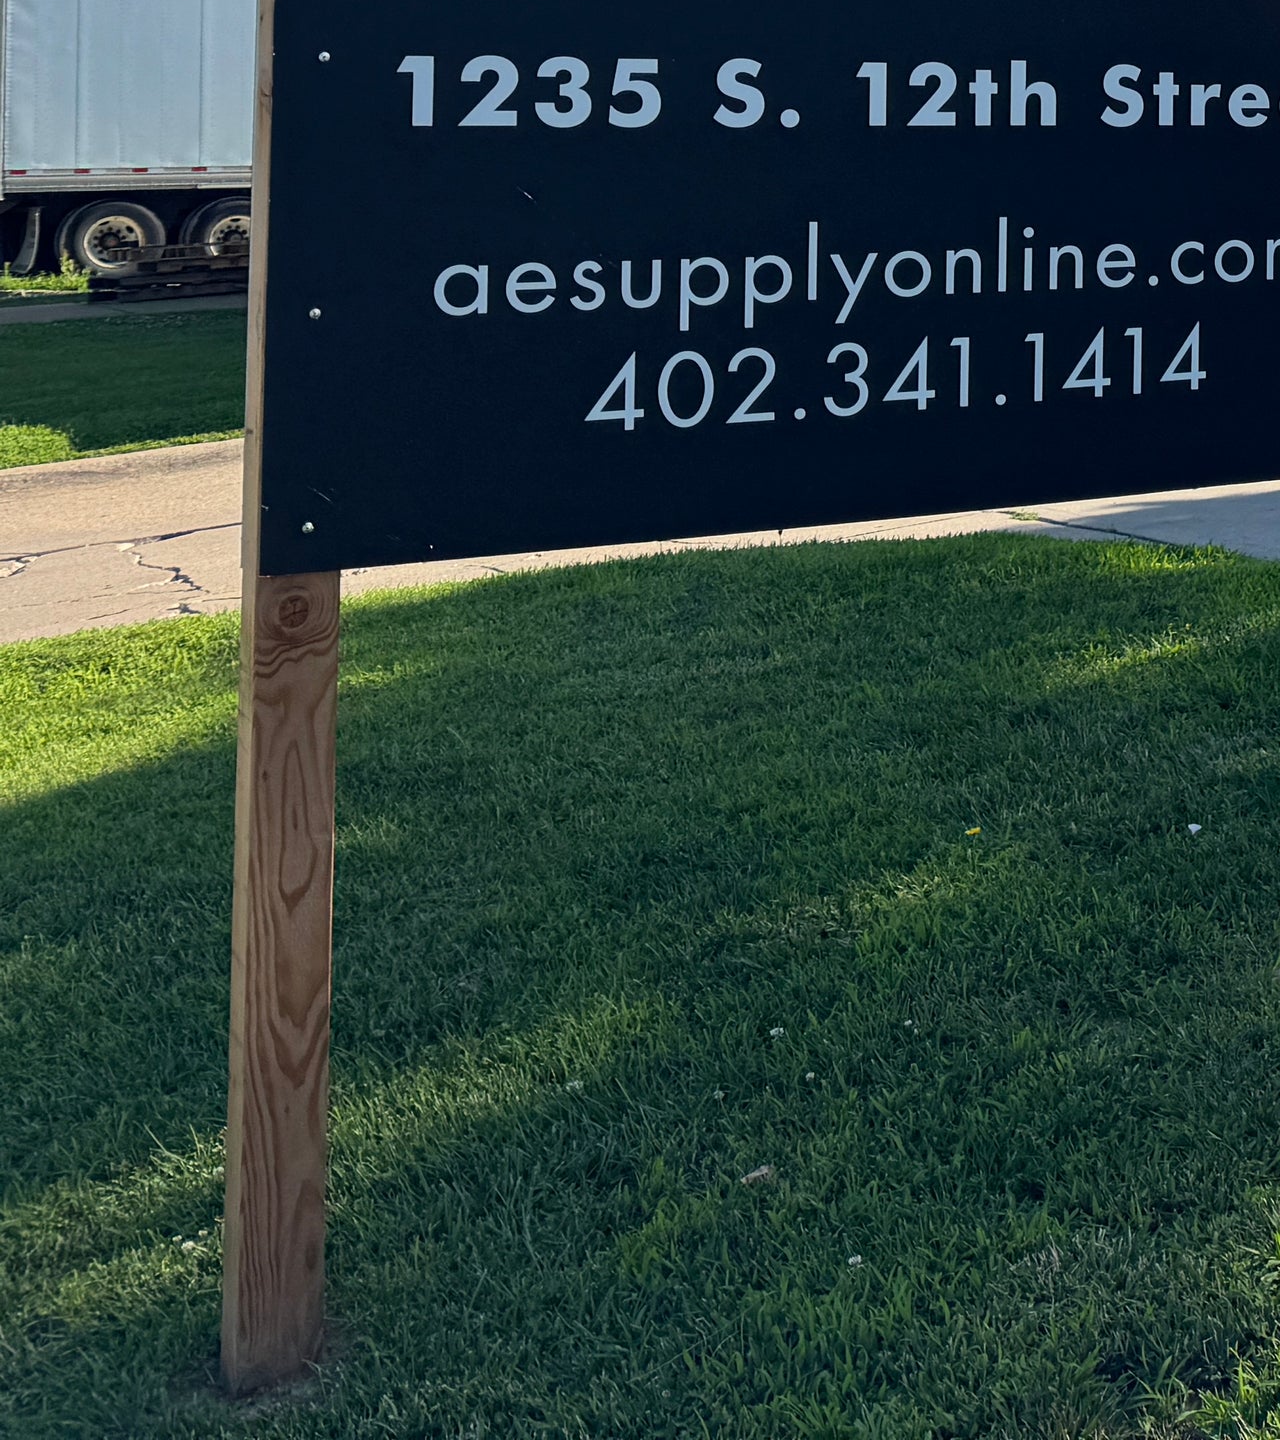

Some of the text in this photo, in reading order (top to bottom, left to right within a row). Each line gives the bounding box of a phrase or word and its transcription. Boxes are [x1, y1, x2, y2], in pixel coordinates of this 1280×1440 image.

[396, 55, 662, 128] 1235
[713, 58, 800, 128] S.
[856, 59, 1057, 127] 12th
[584, 321, 1207, 432] 402.341.1414
